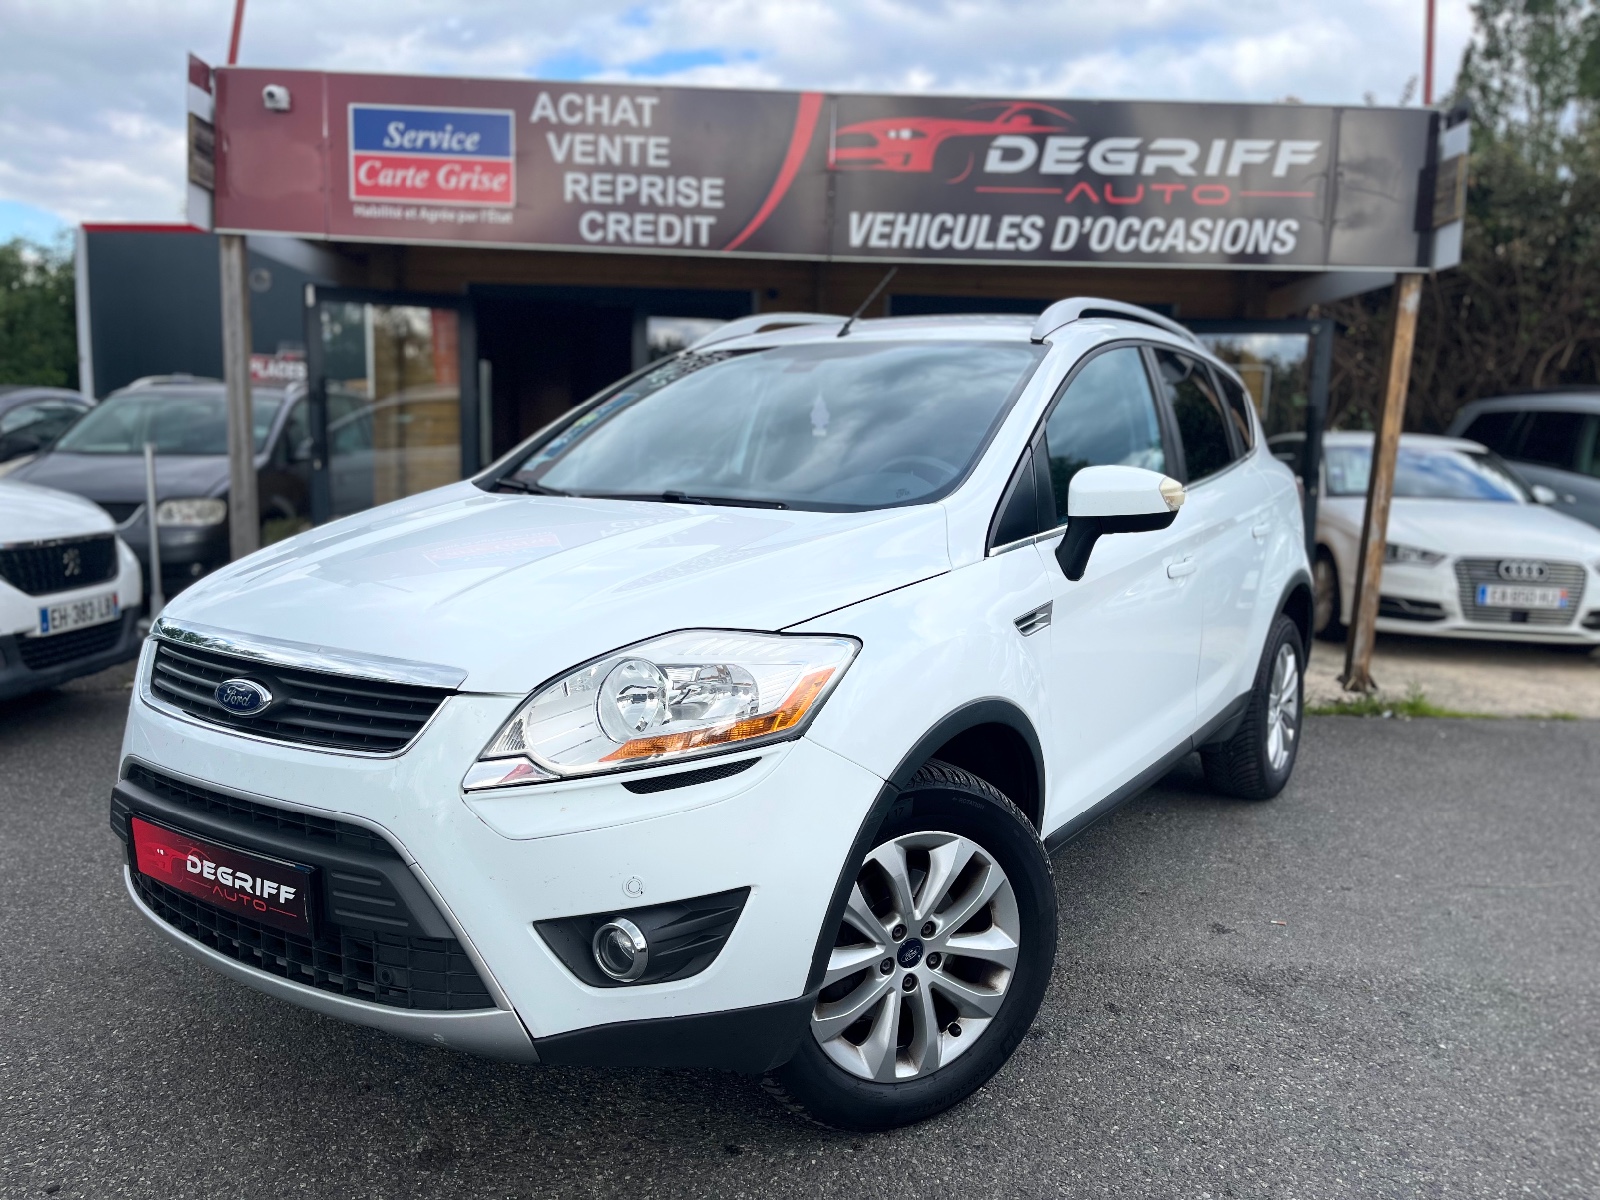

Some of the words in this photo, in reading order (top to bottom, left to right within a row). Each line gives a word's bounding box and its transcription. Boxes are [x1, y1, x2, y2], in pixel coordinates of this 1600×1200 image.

[530, 92, 659, 127] ACHAT
[383, 121, 480, 152] Service
[547, 131, 671, 168] VENTE
[984, 136, 1321, 178] DEGRIFF
[357, 159, 432, 189] Carte
[436, 165, 508, 193] Grise
[563, 171, 724, 208] REPRISE
[1064, 182, 1230, 206] AUTO
[578, 210, 717, 246] CREDIT
[848, 211, 1044, 252] VEHICULES
[1051, 215, 1299, 256] D'OCCASIONS
[223, 685, 252, 706] Ford
[186, 854, 297, 904] DEGRIFF
[212, 885, 267, 912] AUTO
